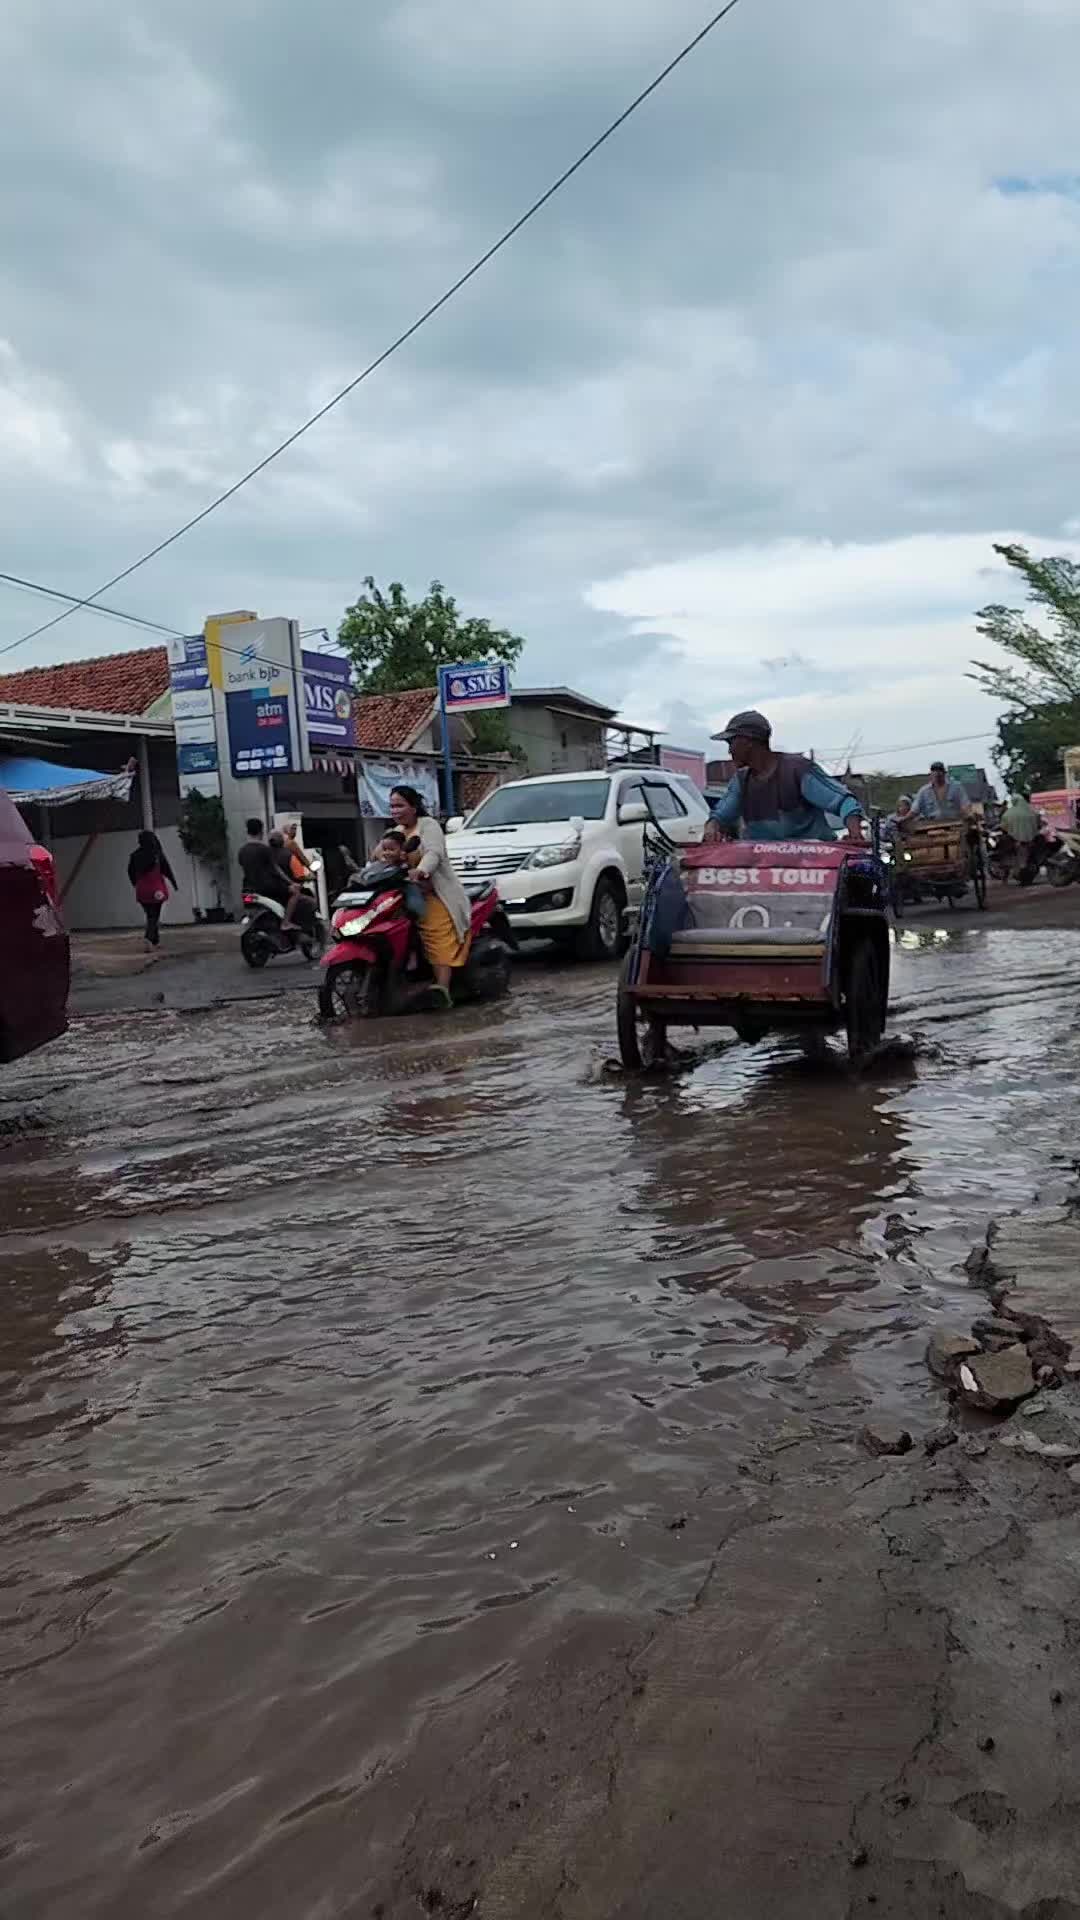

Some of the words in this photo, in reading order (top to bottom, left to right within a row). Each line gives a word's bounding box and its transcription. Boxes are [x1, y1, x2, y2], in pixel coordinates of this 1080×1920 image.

[228, 669, 256, 683] bank
[259, 667, 280, 683] bjb
[467, 673, 501, 693] SMS
[256, 703, 282, 717] atm
[697, 868, 760, 885] Best
[770, 868, 831, 885] Tour
